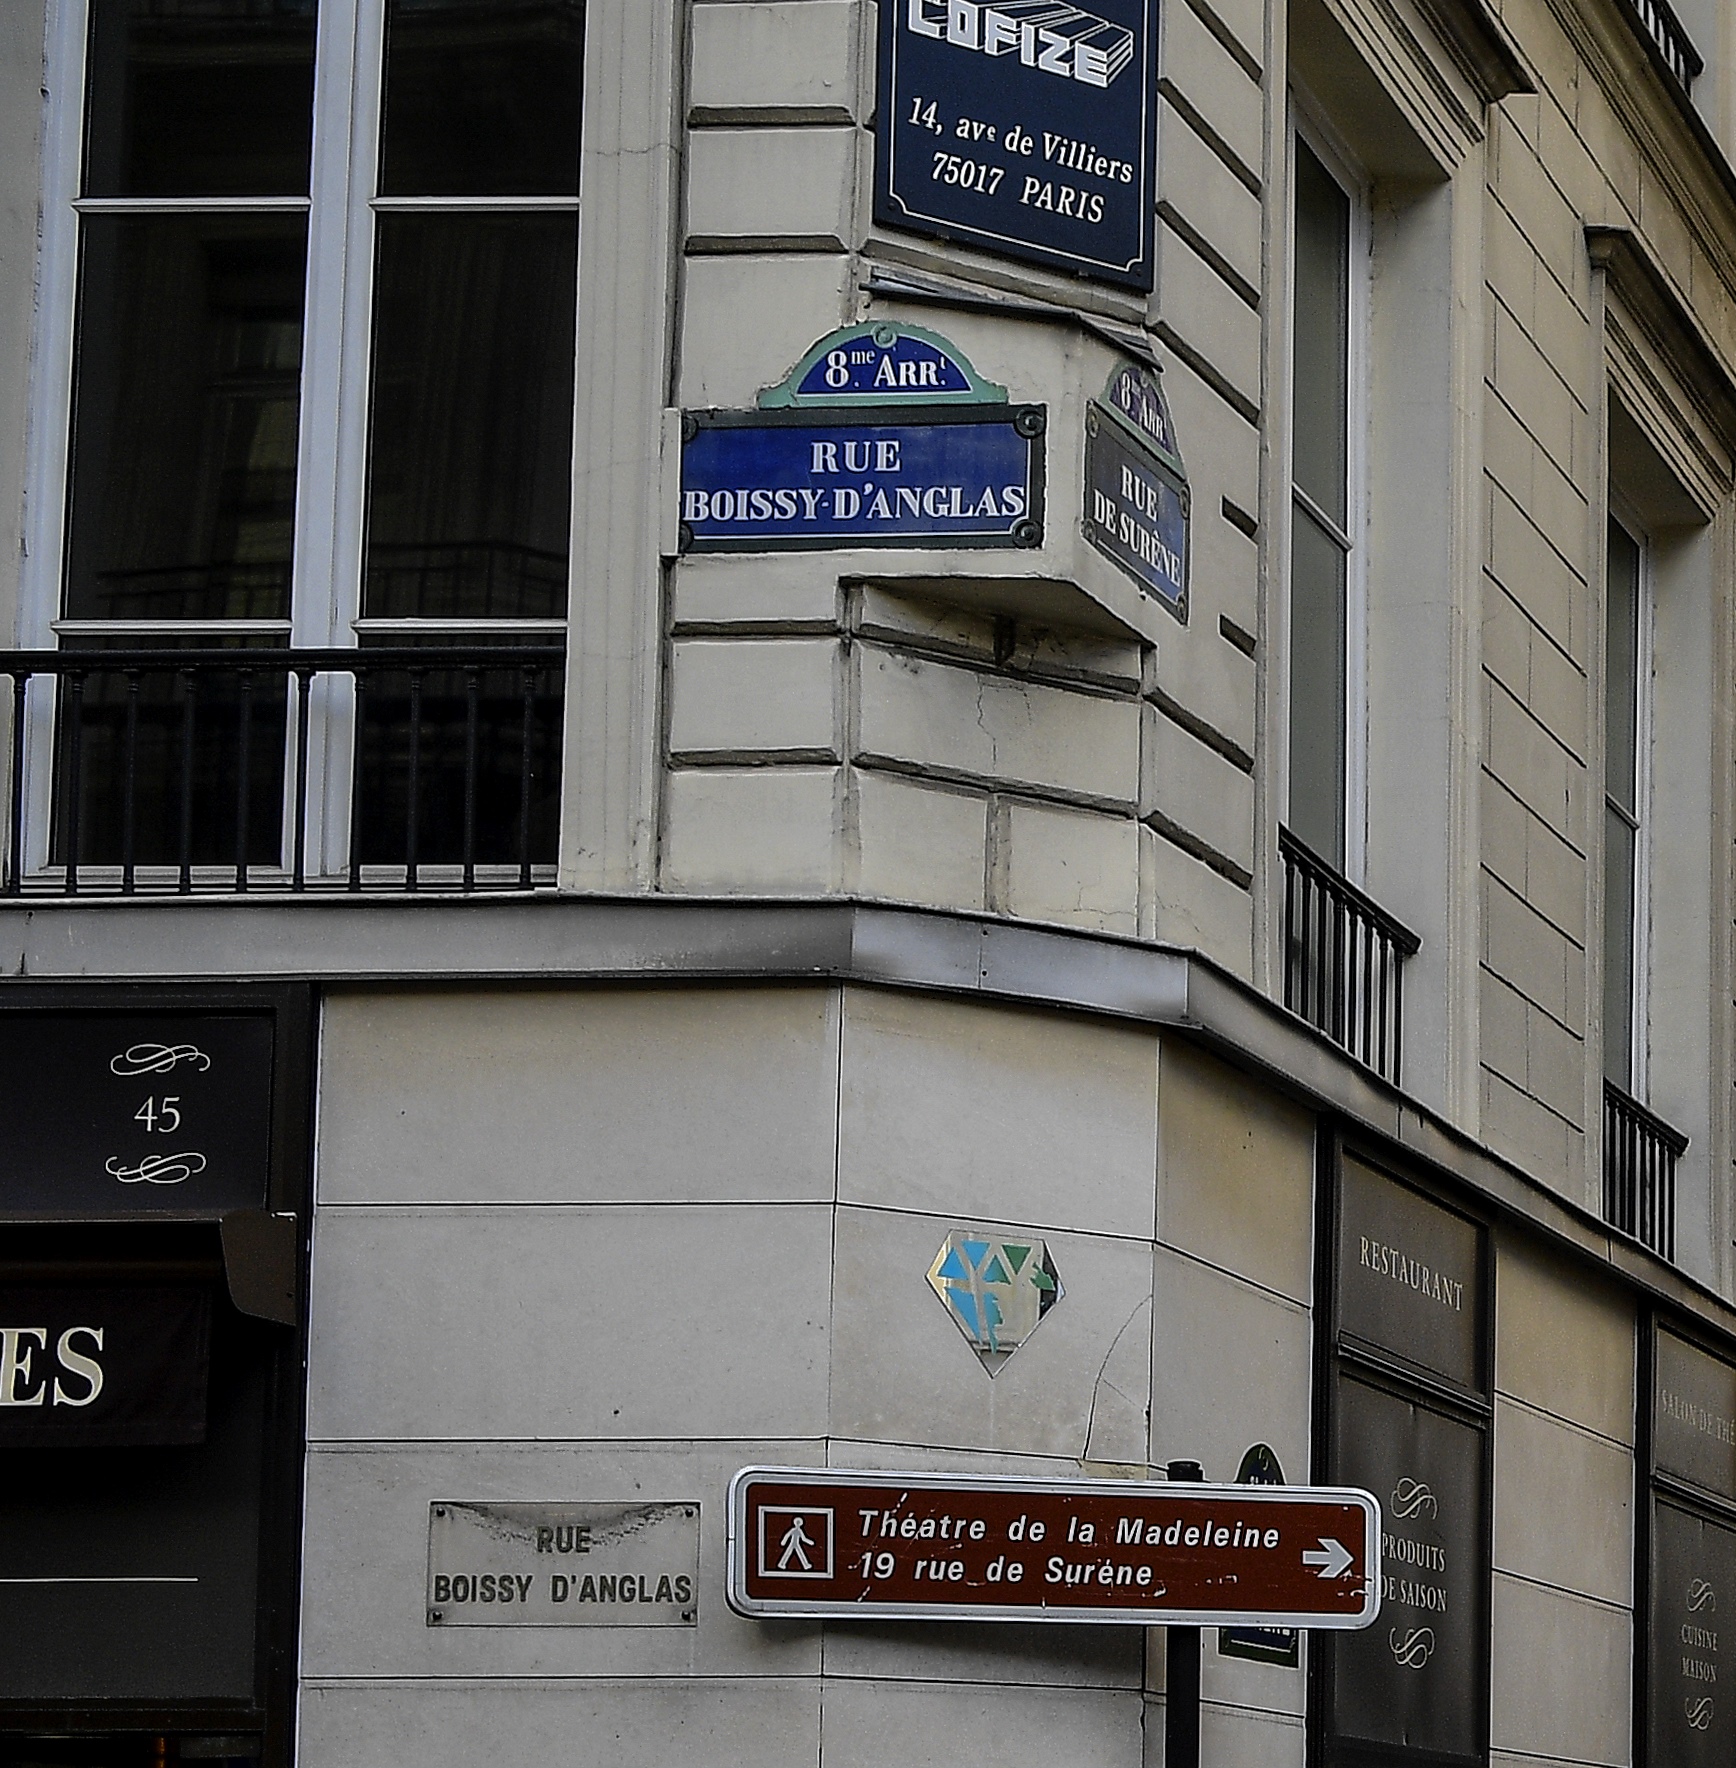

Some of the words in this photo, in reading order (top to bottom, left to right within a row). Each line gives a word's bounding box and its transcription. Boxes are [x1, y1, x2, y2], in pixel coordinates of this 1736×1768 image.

[908, 0, 1134, 88] COFIZE
[908, 97, 943, 135] 14,
[1004, 125, 1035, 156] de
[1042, 131, 1134, 184] Villiers
[931, 152, 1005, 196] 75017
[1018, 176, 1106, 223] PARIS
[809, 439, 902, 474] RUE
[1120, 464, 1158, 523] RUE
[1093, 488, 1117, 536] DE
[1118, 511, 1181, 588] SURÊNE
[133, 1095, 182, 1133] 45
[1359, 1235, 1463, 1312] RESTAURANT
[1661, 1388, 1697, 1426] SALON
[1700, 1408, 1713, 1435] DE
[535, 1525, 593, 1554] RUE
[1008, 1514, 1046, 1542] de
[1067, 1516, 1096, 1543] la
[1115, 1517, 1280, 1549] Madeleine
[860, 1551, 895, 1579] 19
[914, 1560, 965, 1581] rue
[985, 1555, 1025, 1582] de
[1381, 1531, 1447, 1573] PRODUITS
[433, 1574, 534, 1603] BOISSY
[551, 1574, 693, 1603] D'ANGLAS
[1400, 1579, 1448, 1612] SAISON
[1681, 1623, 1718, 1652] CUISINE
[1681, 1656, 1718, 1683] MAISON
